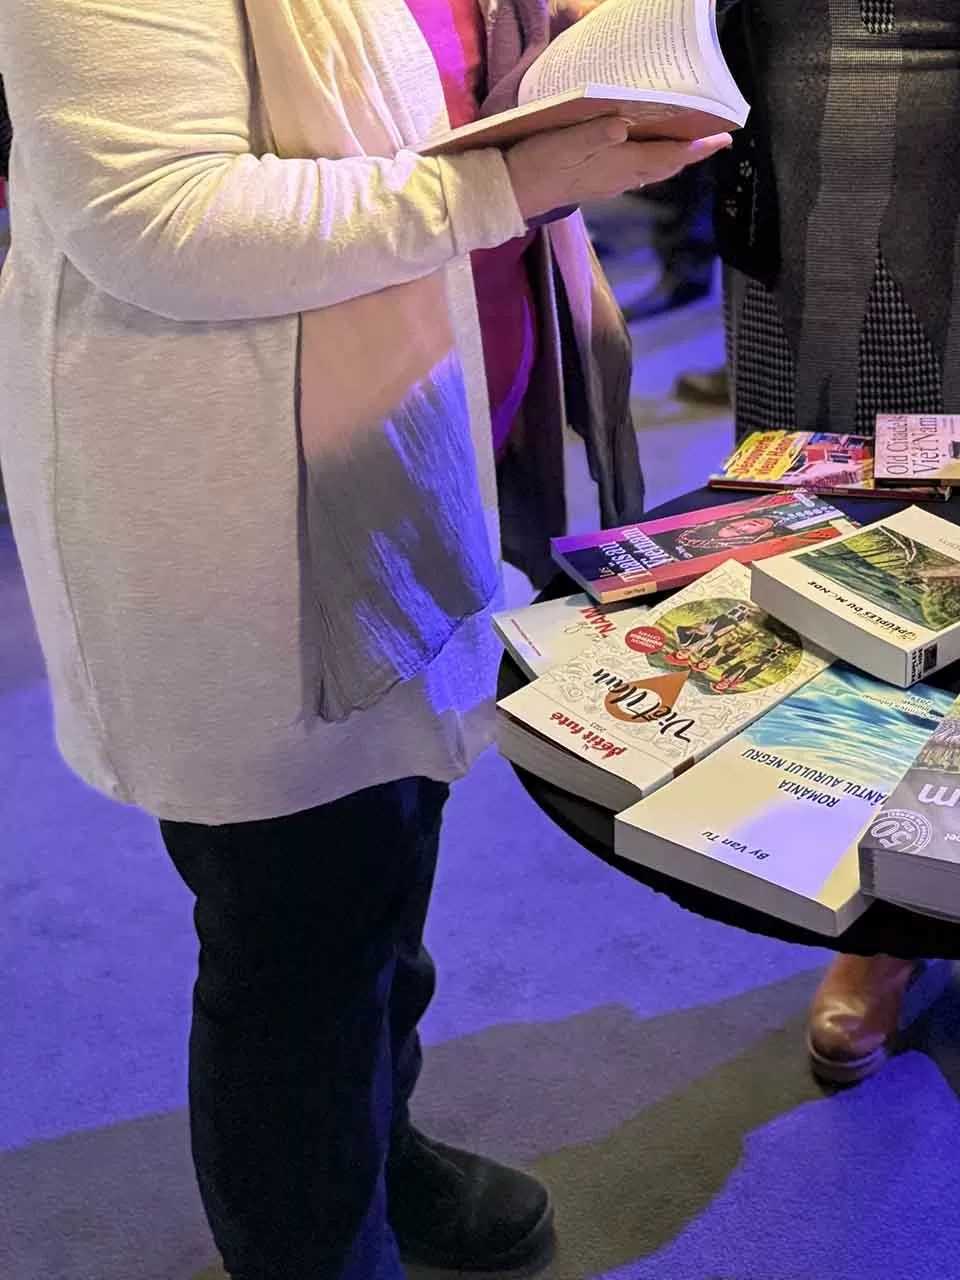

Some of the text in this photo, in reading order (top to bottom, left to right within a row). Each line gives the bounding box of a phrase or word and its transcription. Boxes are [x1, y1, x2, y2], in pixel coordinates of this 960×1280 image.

[910, 416, 939, 442] Nam
[885, 455, 909, 475] Old
[620, 527, 675, 569] Vietnam
[847, 602, 864, 613] DU
[550, 711, 627, 760] petit futé
[741, 747, 787, 770] NEGRU
[783, 761, 843, 789] AURULUI
[777, 779, 841, 808] ROMÂNIA
[701, 830, 770, 862] By Van Tu
[869, 819, 911, 848] 50
